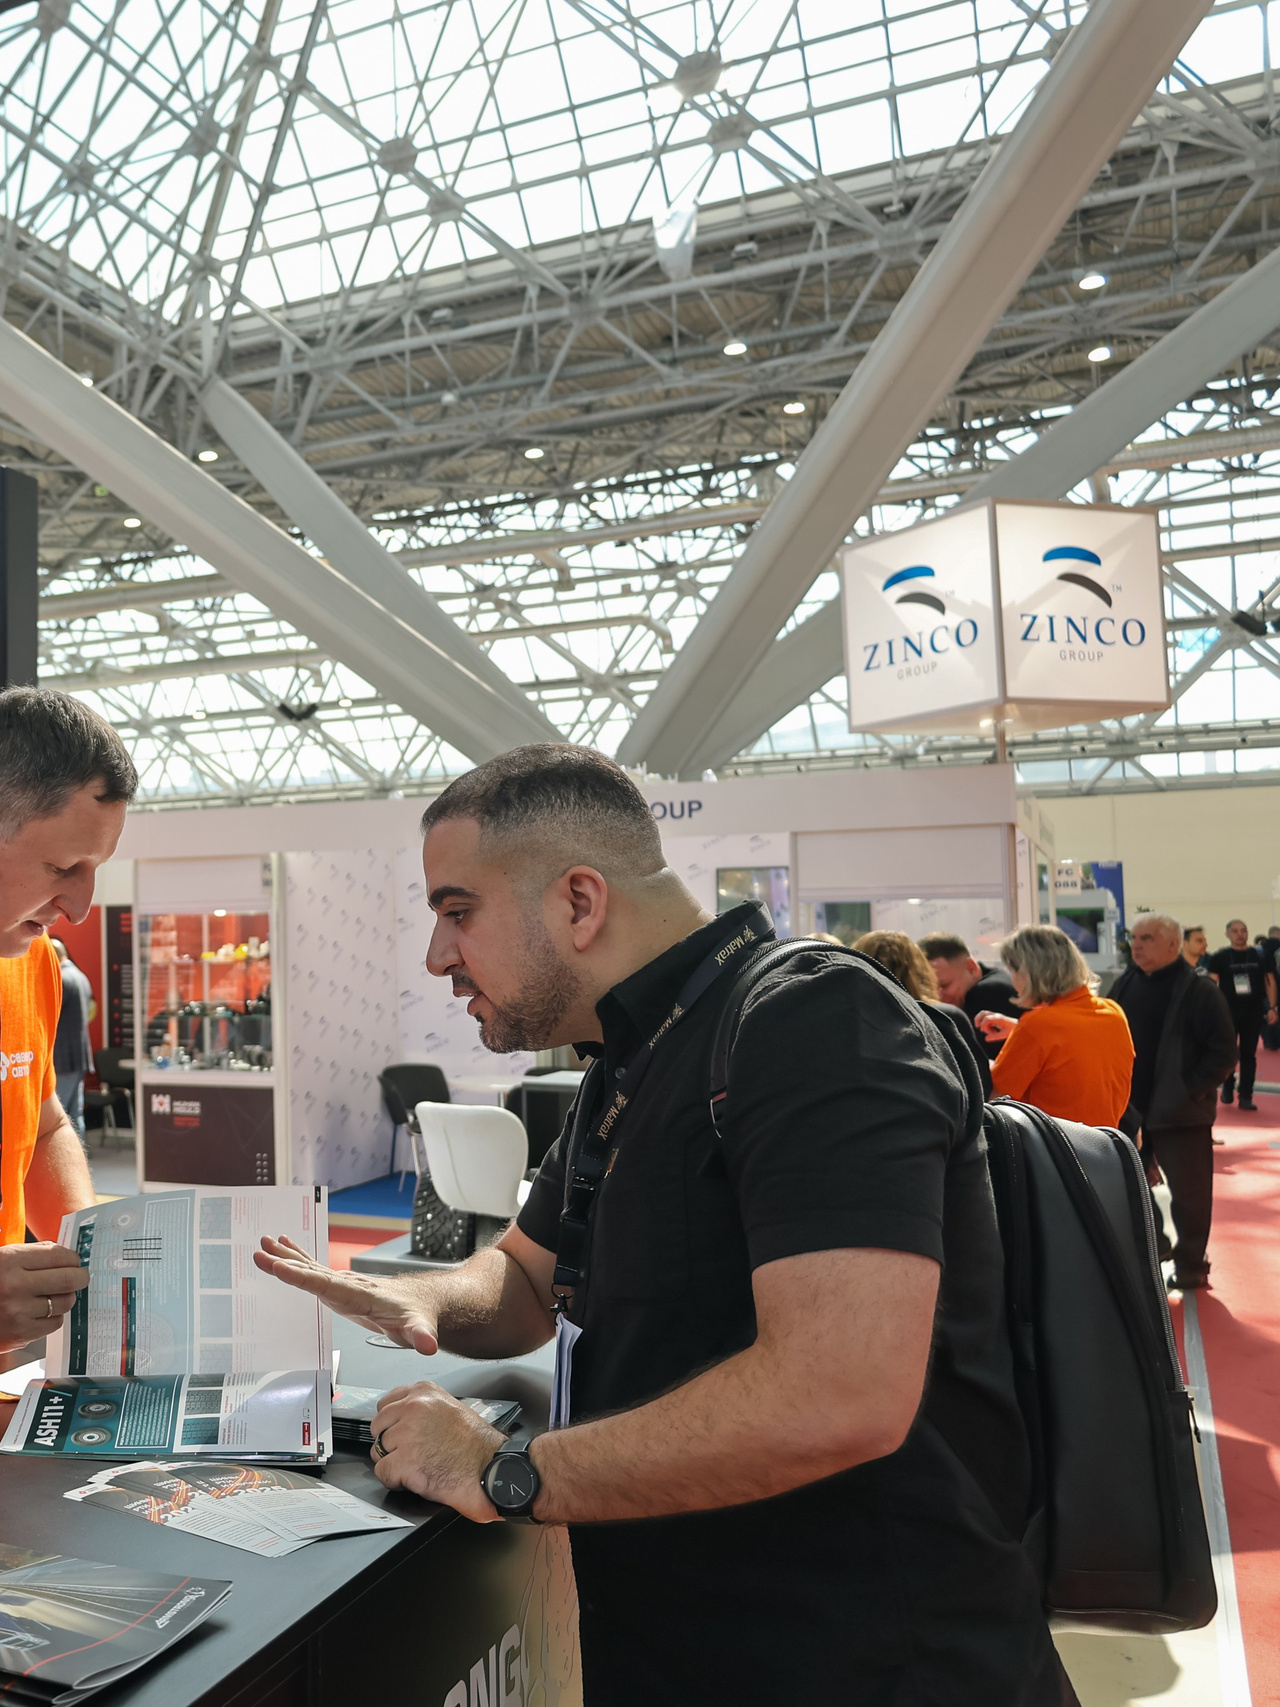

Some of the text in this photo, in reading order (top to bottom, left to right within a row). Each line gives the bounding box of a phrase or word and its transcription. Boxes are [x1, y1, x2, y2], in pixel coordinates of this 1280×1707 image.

[1019, 613, 1146, 647] ZINCO
[863, 618, 978, 671] ZINCO
[1059, 649, 1104, 661] GROUP
[897, 661, 938, 680] GROUP
[651, 800, 703, 820] OUP
